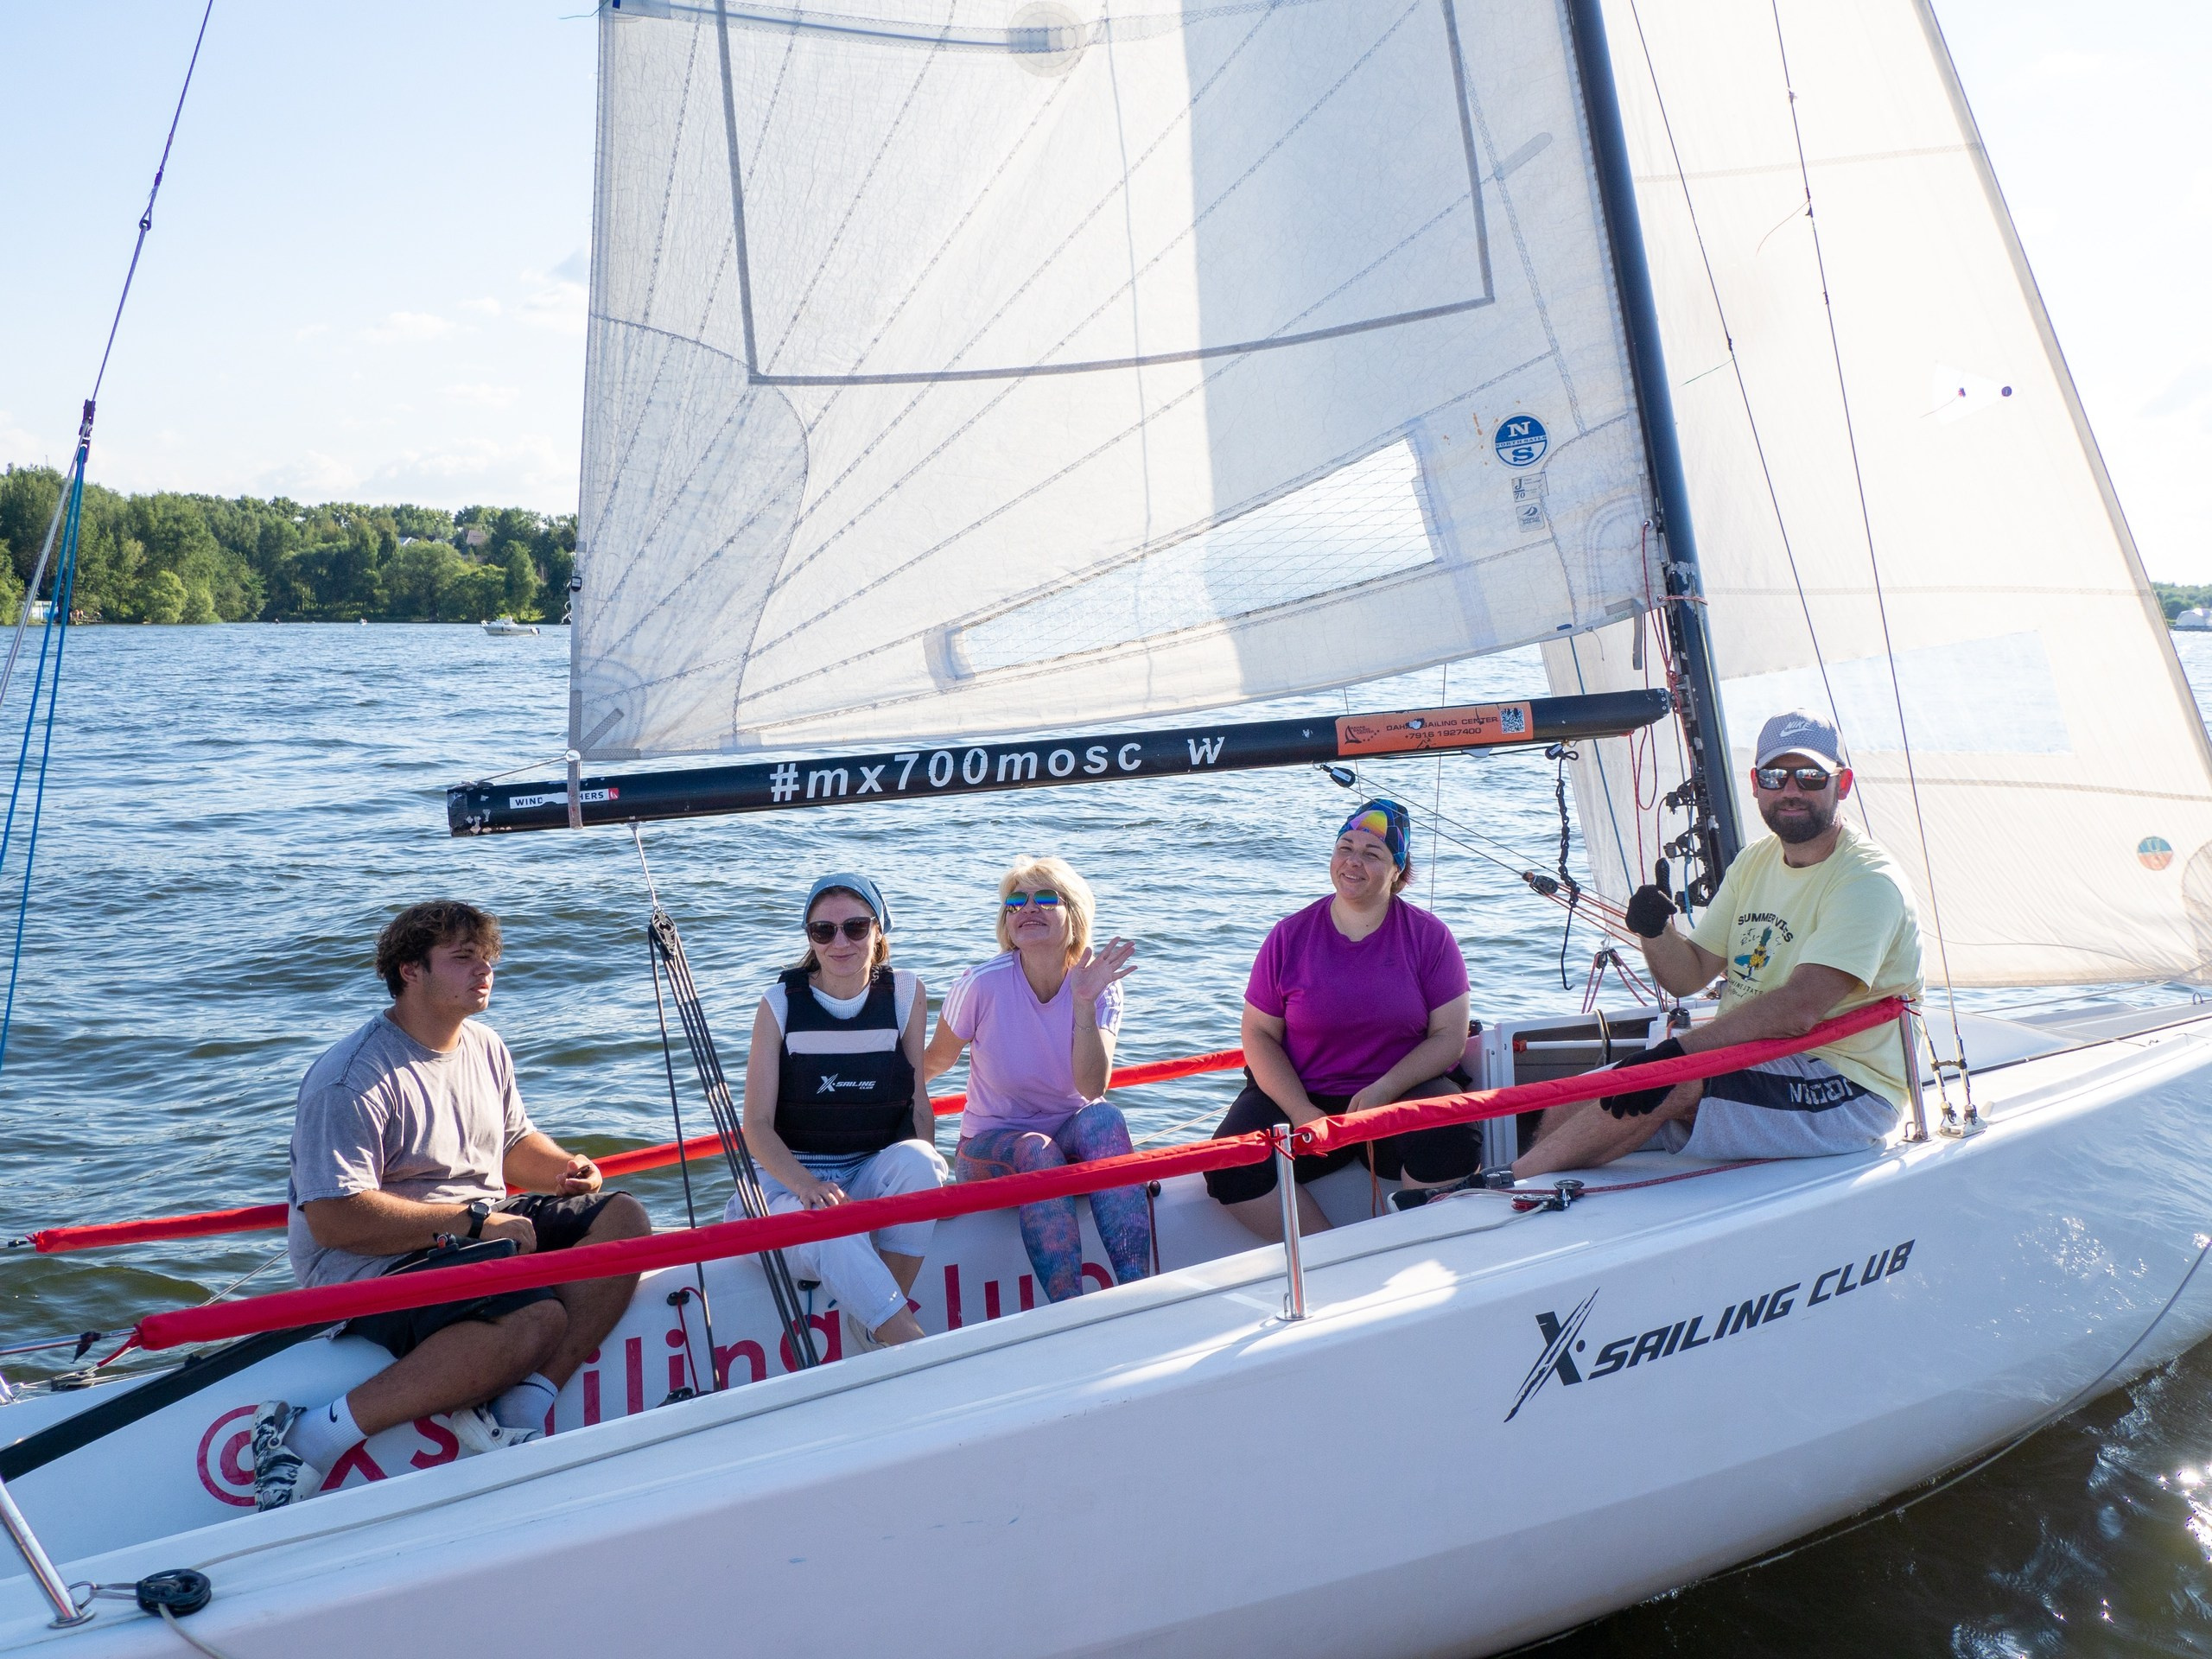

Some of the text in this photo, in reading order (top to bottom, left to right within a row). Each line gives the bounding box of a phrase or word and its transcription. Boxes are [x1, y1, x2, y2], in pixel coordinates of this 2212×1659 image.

[1506, 421, 1531, 437] N
[1511, 446, 1535, 462] S
[1514, 478, 1522, 490] J
[1386, 721, 1417, 731] DAH
[1461, 716, 1499, 726] CENTER
[1784, 721, 1811, 730] NIKE
[1437, 728, 1483, 737] 1927400
[1738, 912, 1777, 925] SUMMER
[1587, 1281, 1802, 1381] SAILING
[1807, 1238, 1916, 1307] CLUB
